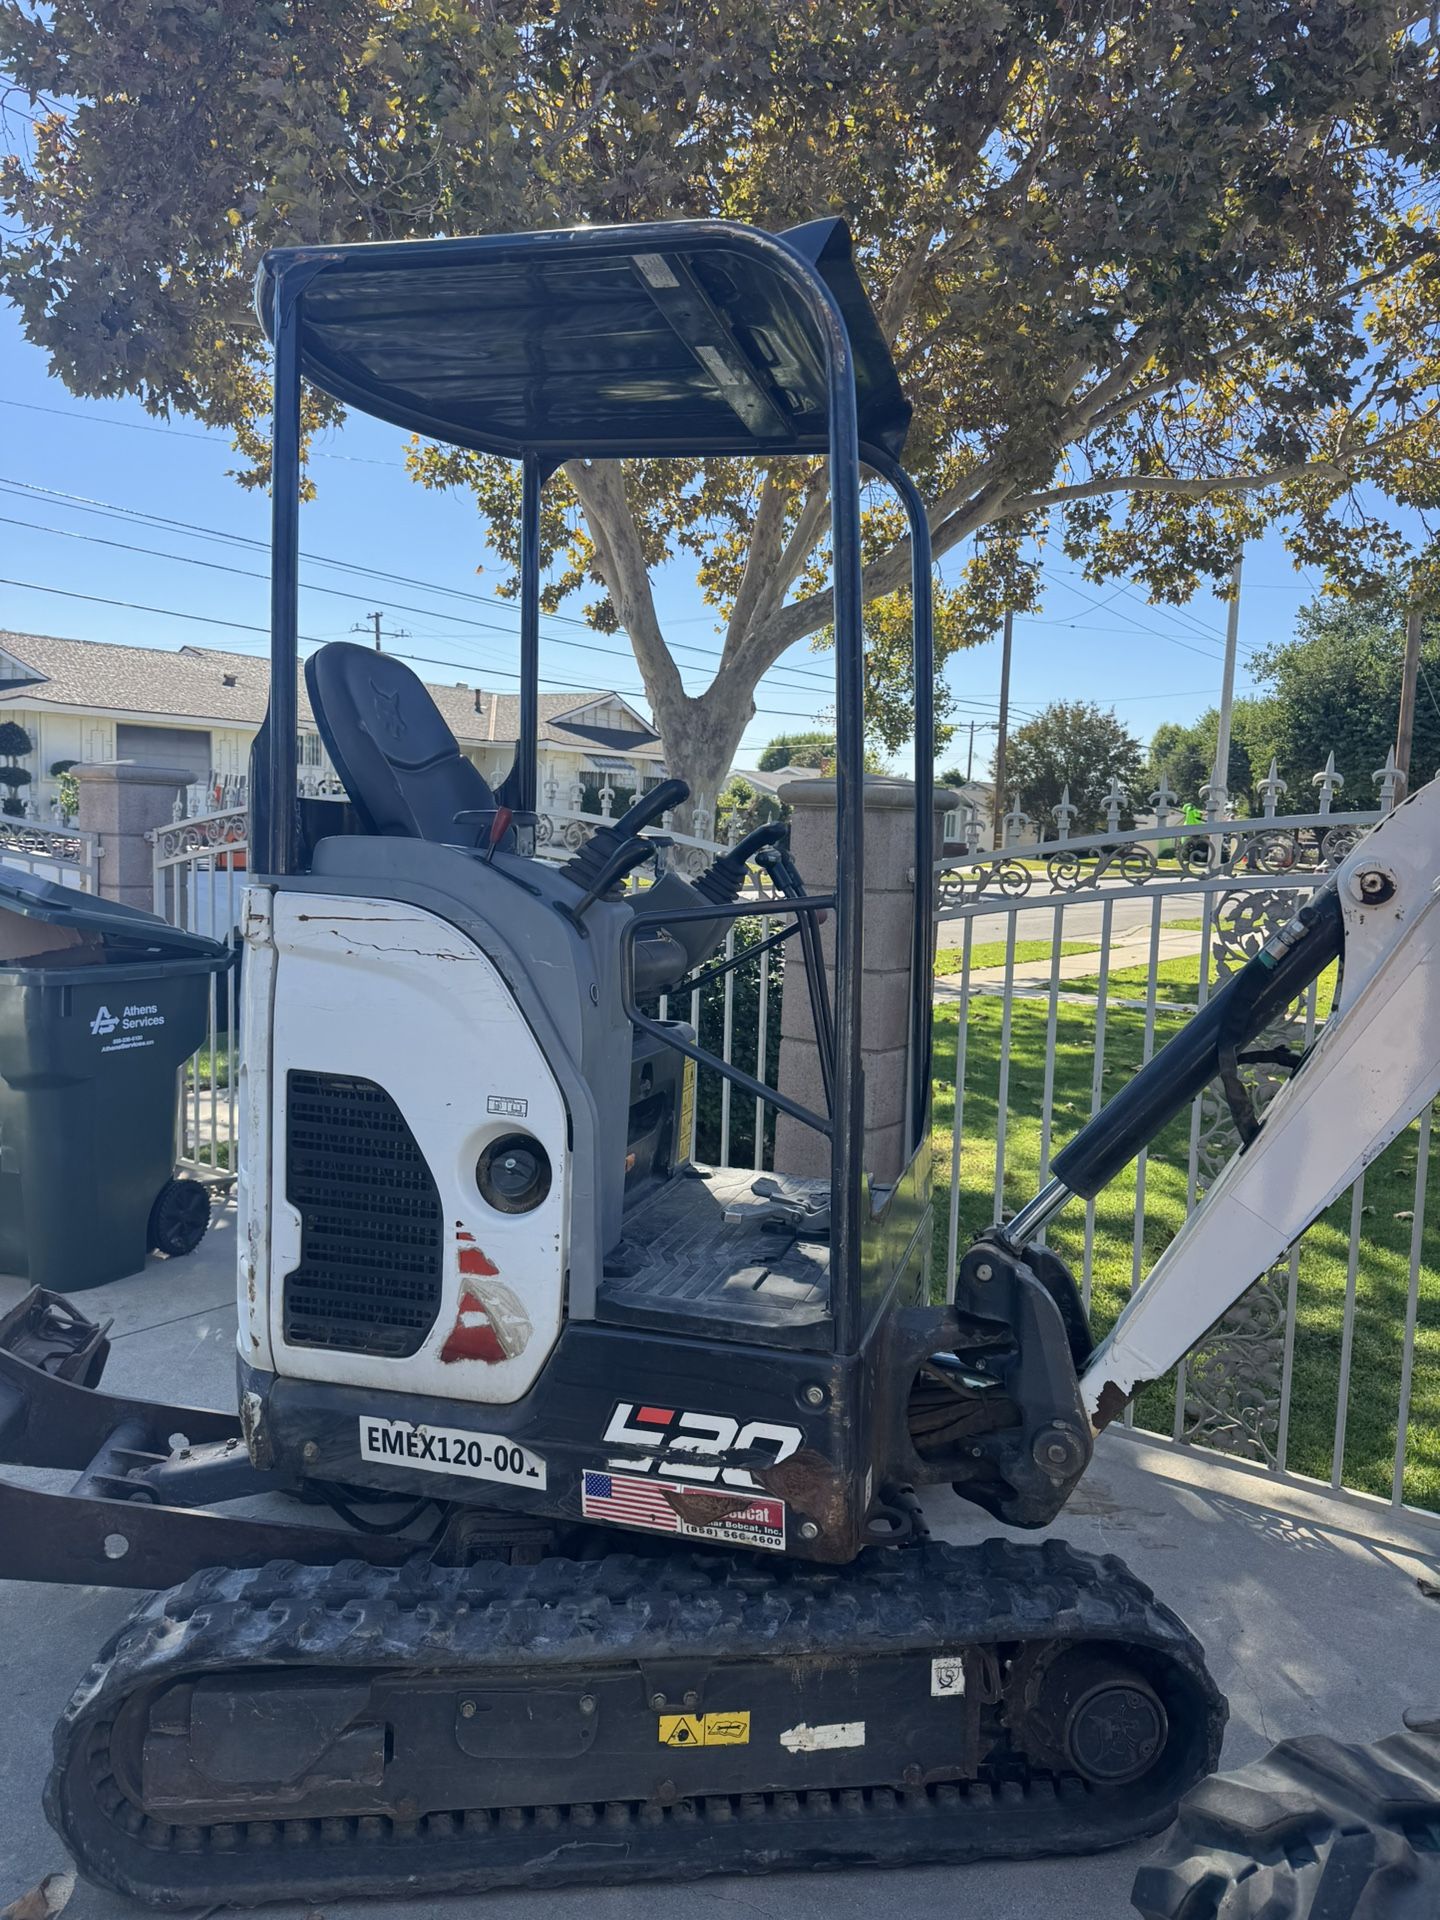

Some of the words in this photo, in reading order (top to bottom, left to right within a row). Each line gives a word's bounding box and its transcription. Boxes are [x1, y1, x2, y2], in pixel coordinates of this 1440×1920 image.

[123, 1005, 158, 1017] Athens
[122, 1016, 165, 1029] Services
[725, 1521, 761, 1533] Bobcat,
[764, 1527, 782, 1536] Inc.
[723, 1530, 781, 1546] 566-4600
